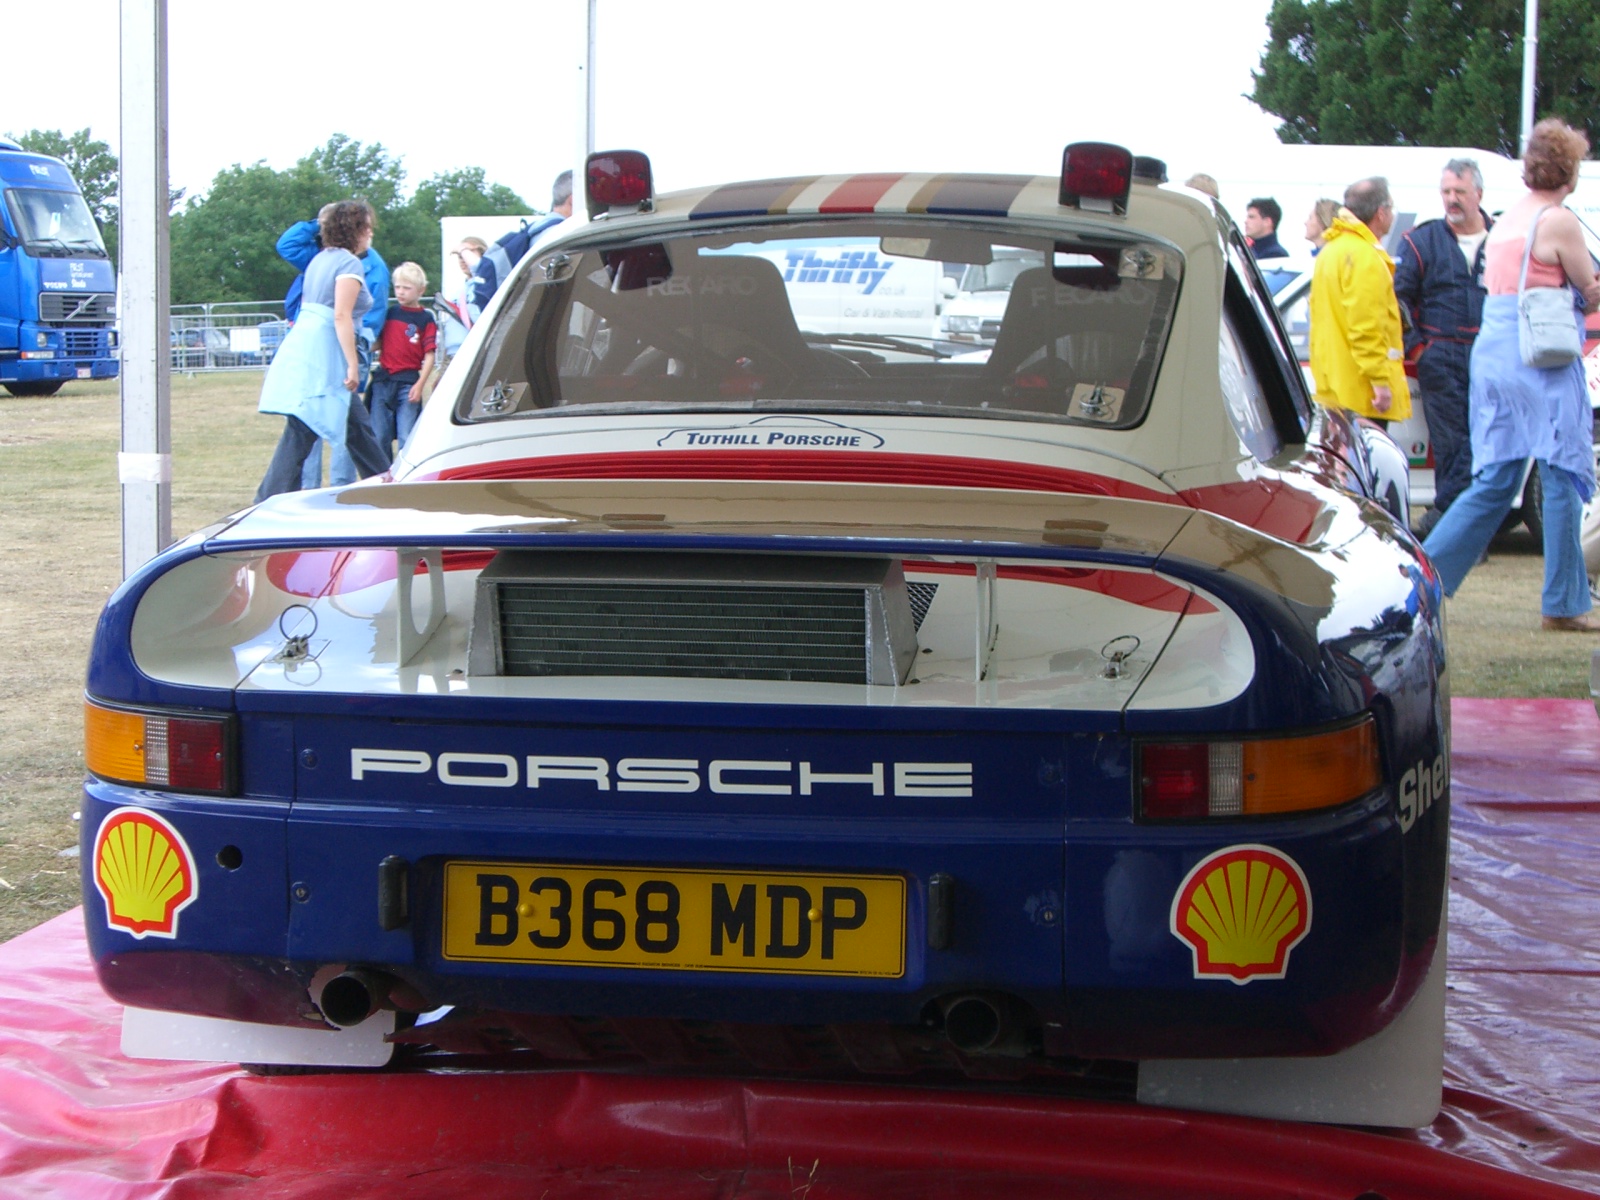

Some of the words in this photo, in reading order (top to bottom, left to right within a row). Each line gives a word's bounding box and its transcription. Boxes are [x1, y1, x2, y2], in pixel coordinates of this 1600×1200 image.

[43, 281, 68, 289] VOLVO
[784, 249, 894, 295] Thrifty
[844, 308, 860, 319] Car
[862, 308, 870, 319] &
[872, 308, 891, 319] Van
[892, 307, 925, 319] Rental
[351, 748, 973, 798] PORSCHE
[475, 873, 681, 954] B368
[710, 883, 868, 960] MDP
